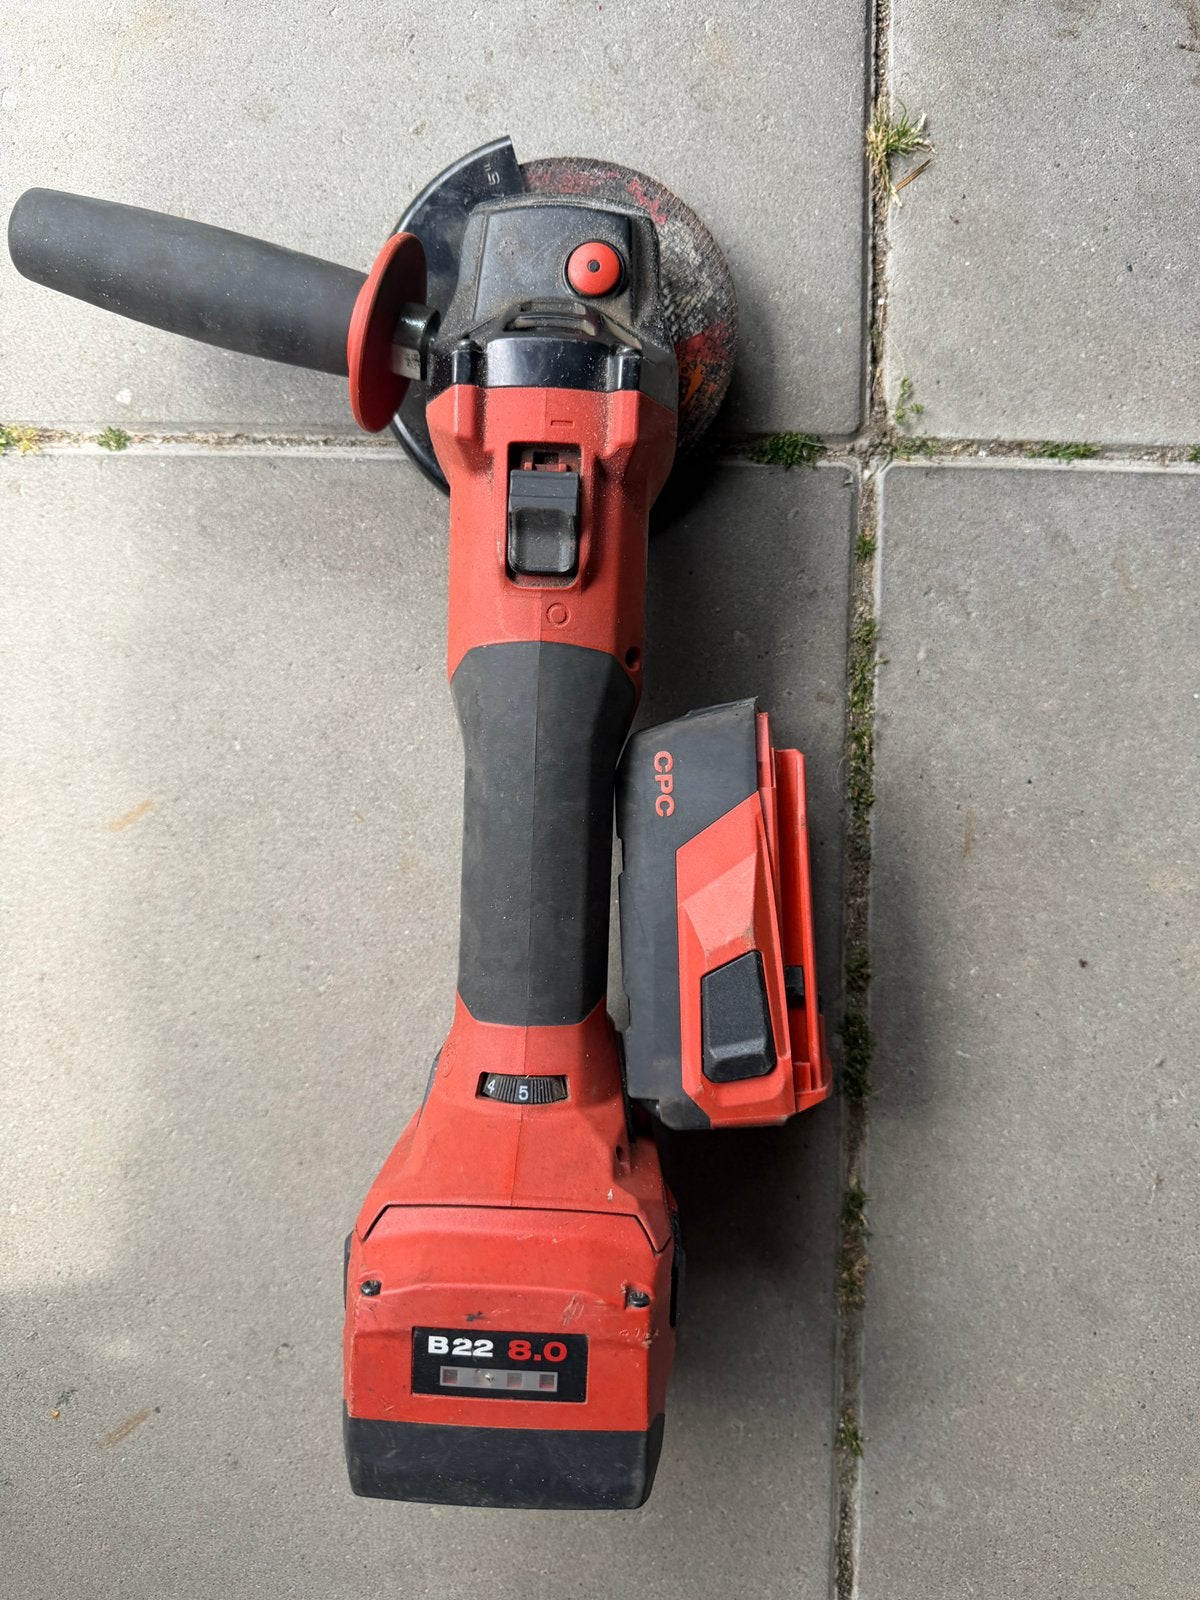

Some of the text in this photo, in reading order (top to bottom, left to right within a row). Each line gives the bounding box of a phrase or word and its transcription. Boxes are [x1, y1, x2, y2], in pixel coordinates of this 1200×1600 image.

[654, 750, 675, 817] CPC
[487, 1079, 496, 1094] 4
[518, 1085, 529, 1101] 5
[427, 1335, 568, 1363] B22 8.0
